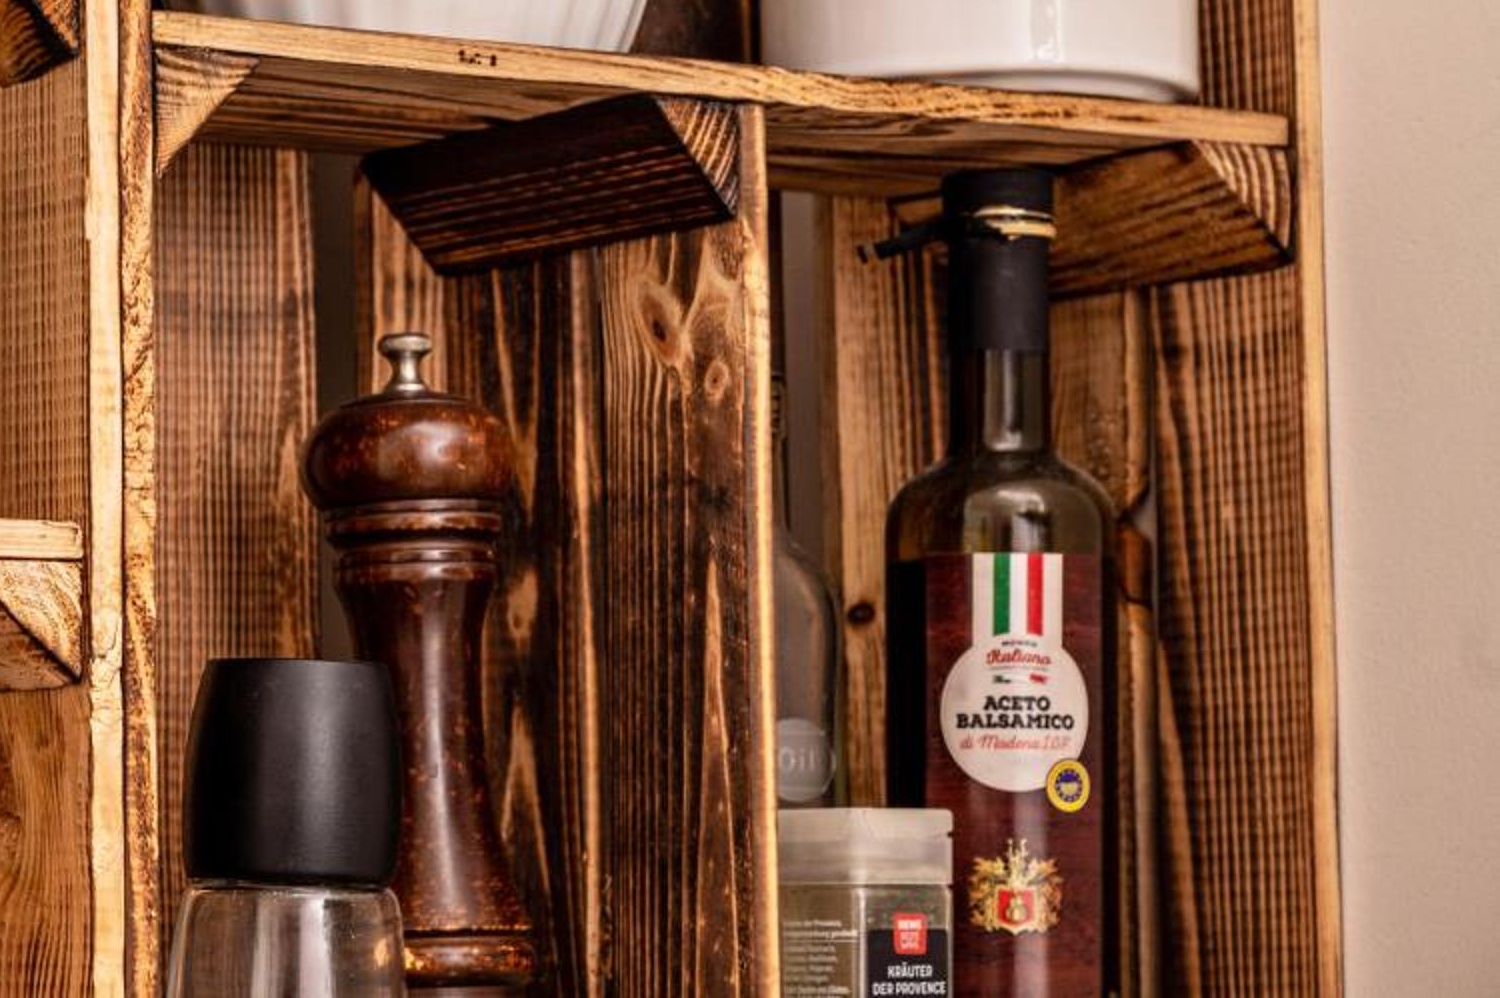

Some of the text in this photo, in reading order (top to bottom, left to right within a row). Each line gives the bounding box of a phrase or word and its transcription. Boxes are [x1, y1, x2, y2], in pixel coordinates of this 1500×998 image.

[983, 696, 1052, 712] ACETO
[956, 714, 1075, 730] BALSAMICO
[960, 734, 973, 749] di
[978, 734, 1039, 750] Modena
[887, 962, 933, 978] KRÄUTER
[872, 981, 947, 997] DER PROVENCE
